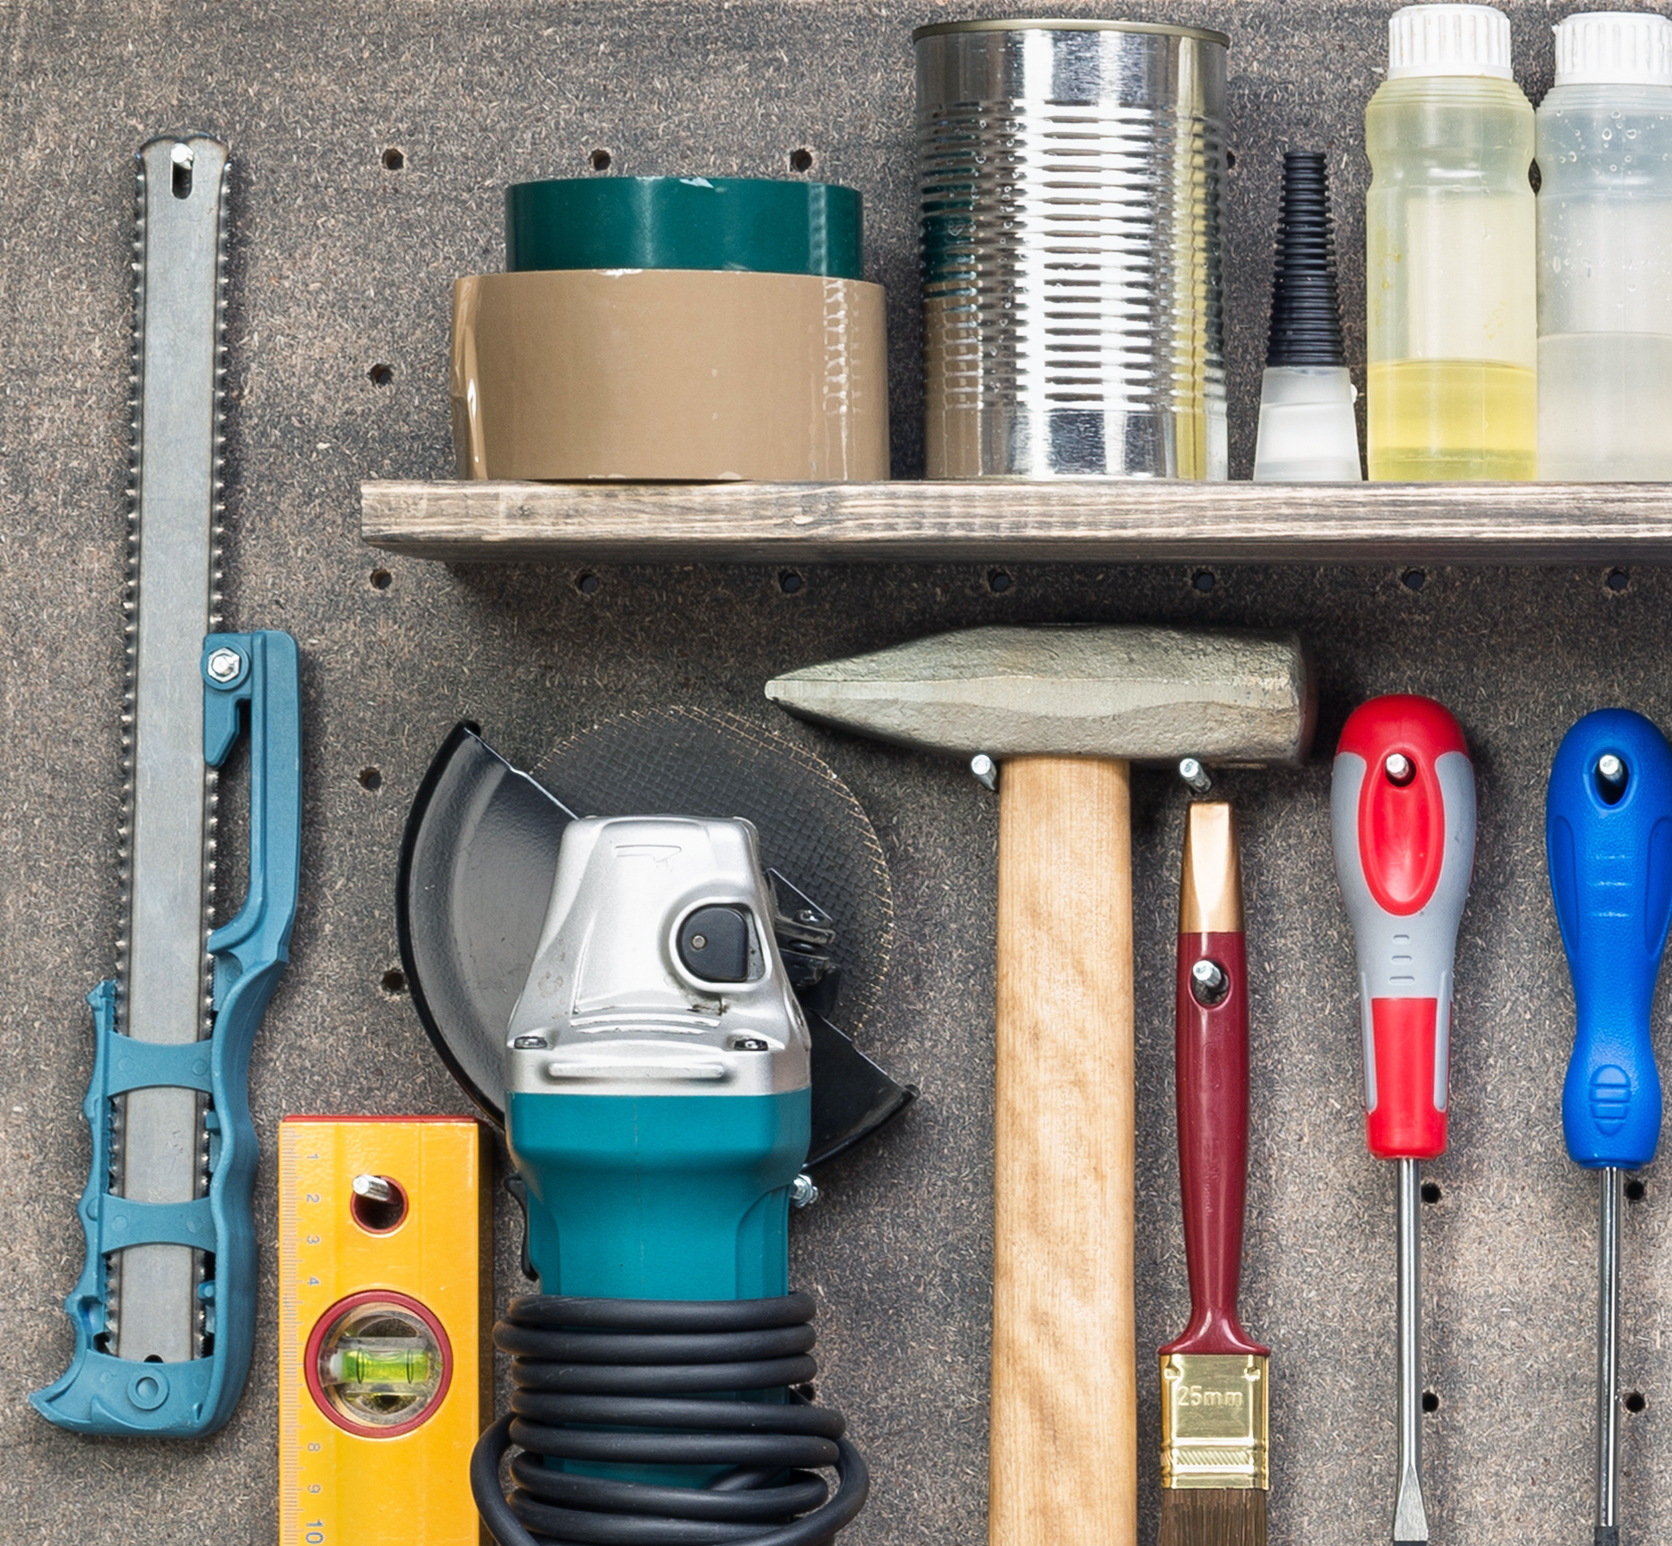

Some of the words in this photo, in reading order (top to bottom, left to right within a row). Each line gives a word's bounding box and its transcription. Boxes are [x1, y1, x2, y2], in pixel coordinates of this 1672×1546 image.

[307, 1153, 321, 1161] 1
[305, 1192, 323, 1204] 2
[305, 1234, 323, 1246] 3
[306, 1275, 322, 1288] 4
[1177, 1385, 1243, 1407] 25mm
[306, 1440, 323, 1454] 8
[306, 1482, 323, 1496] 9
[304, 1518, 326, 1546] 10
